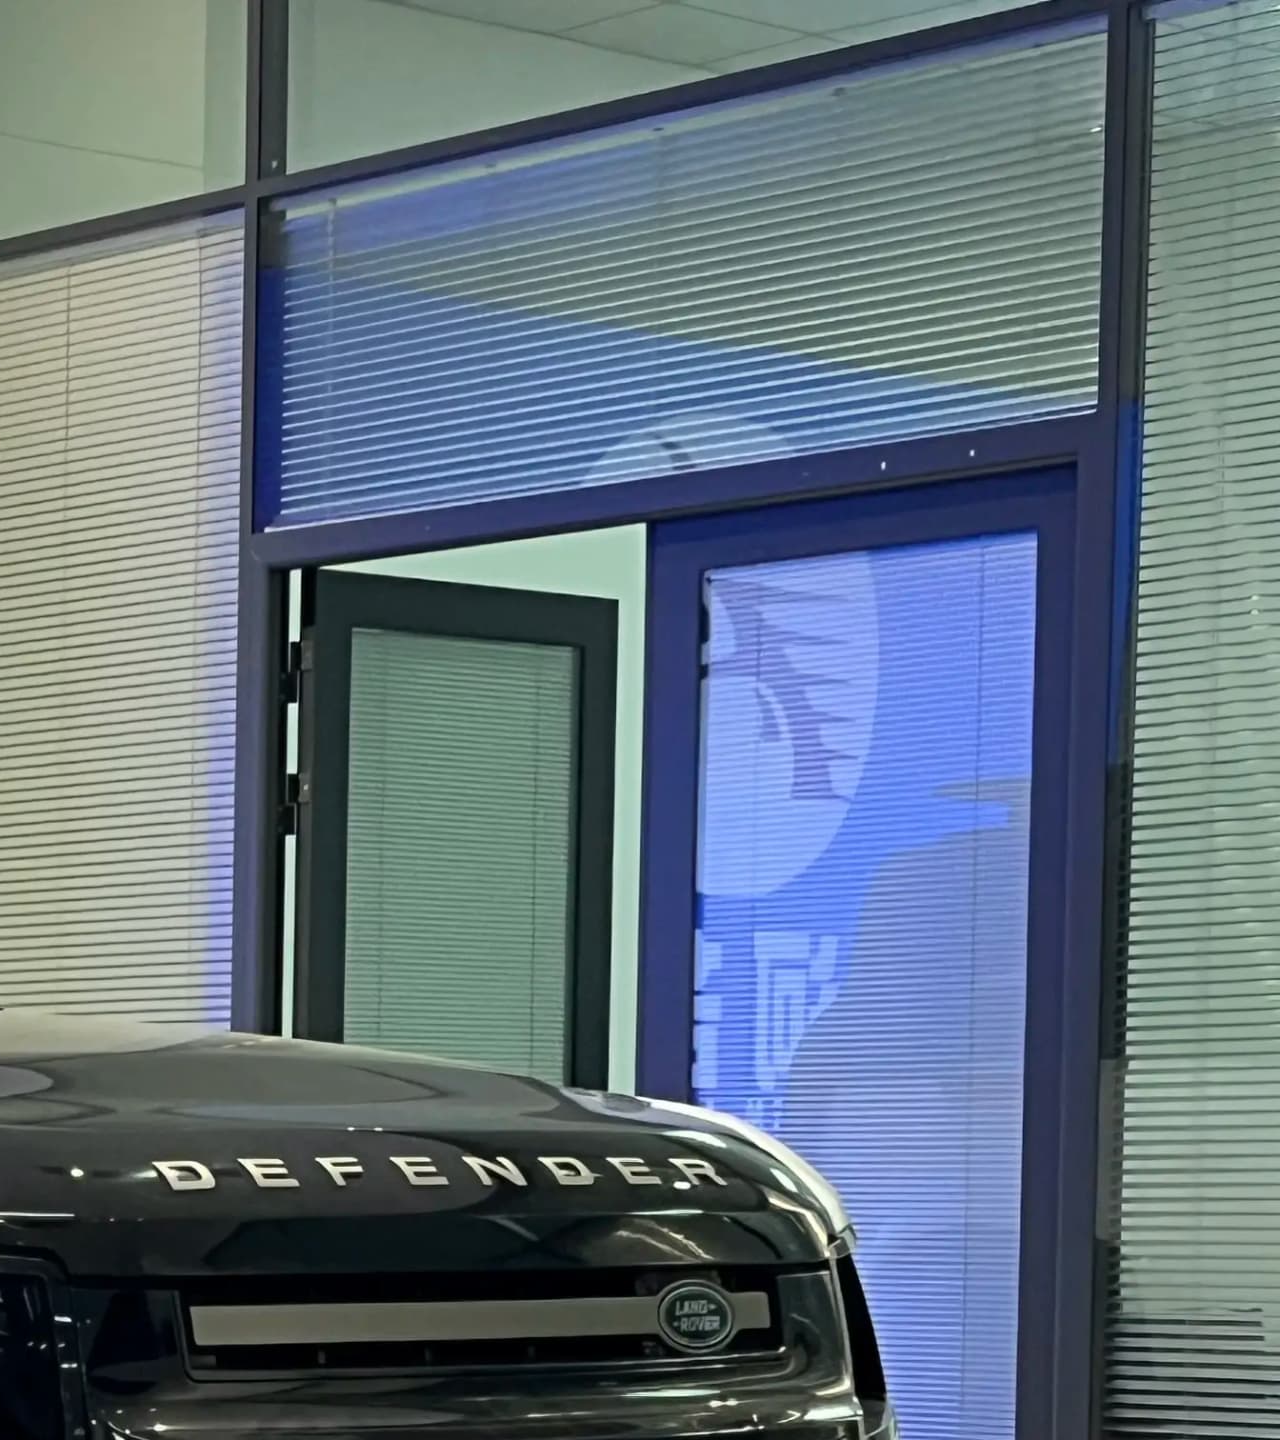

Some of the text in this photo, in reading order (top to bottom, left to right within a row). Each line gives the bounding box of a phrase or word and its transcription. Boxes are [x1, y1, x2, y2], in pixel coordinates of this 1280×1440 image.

[151, 1156, 728, 1191] DEFENDER
[675, 1300, 708, 1316] LAND
[680, 1315, 721, 1333] ROVER
